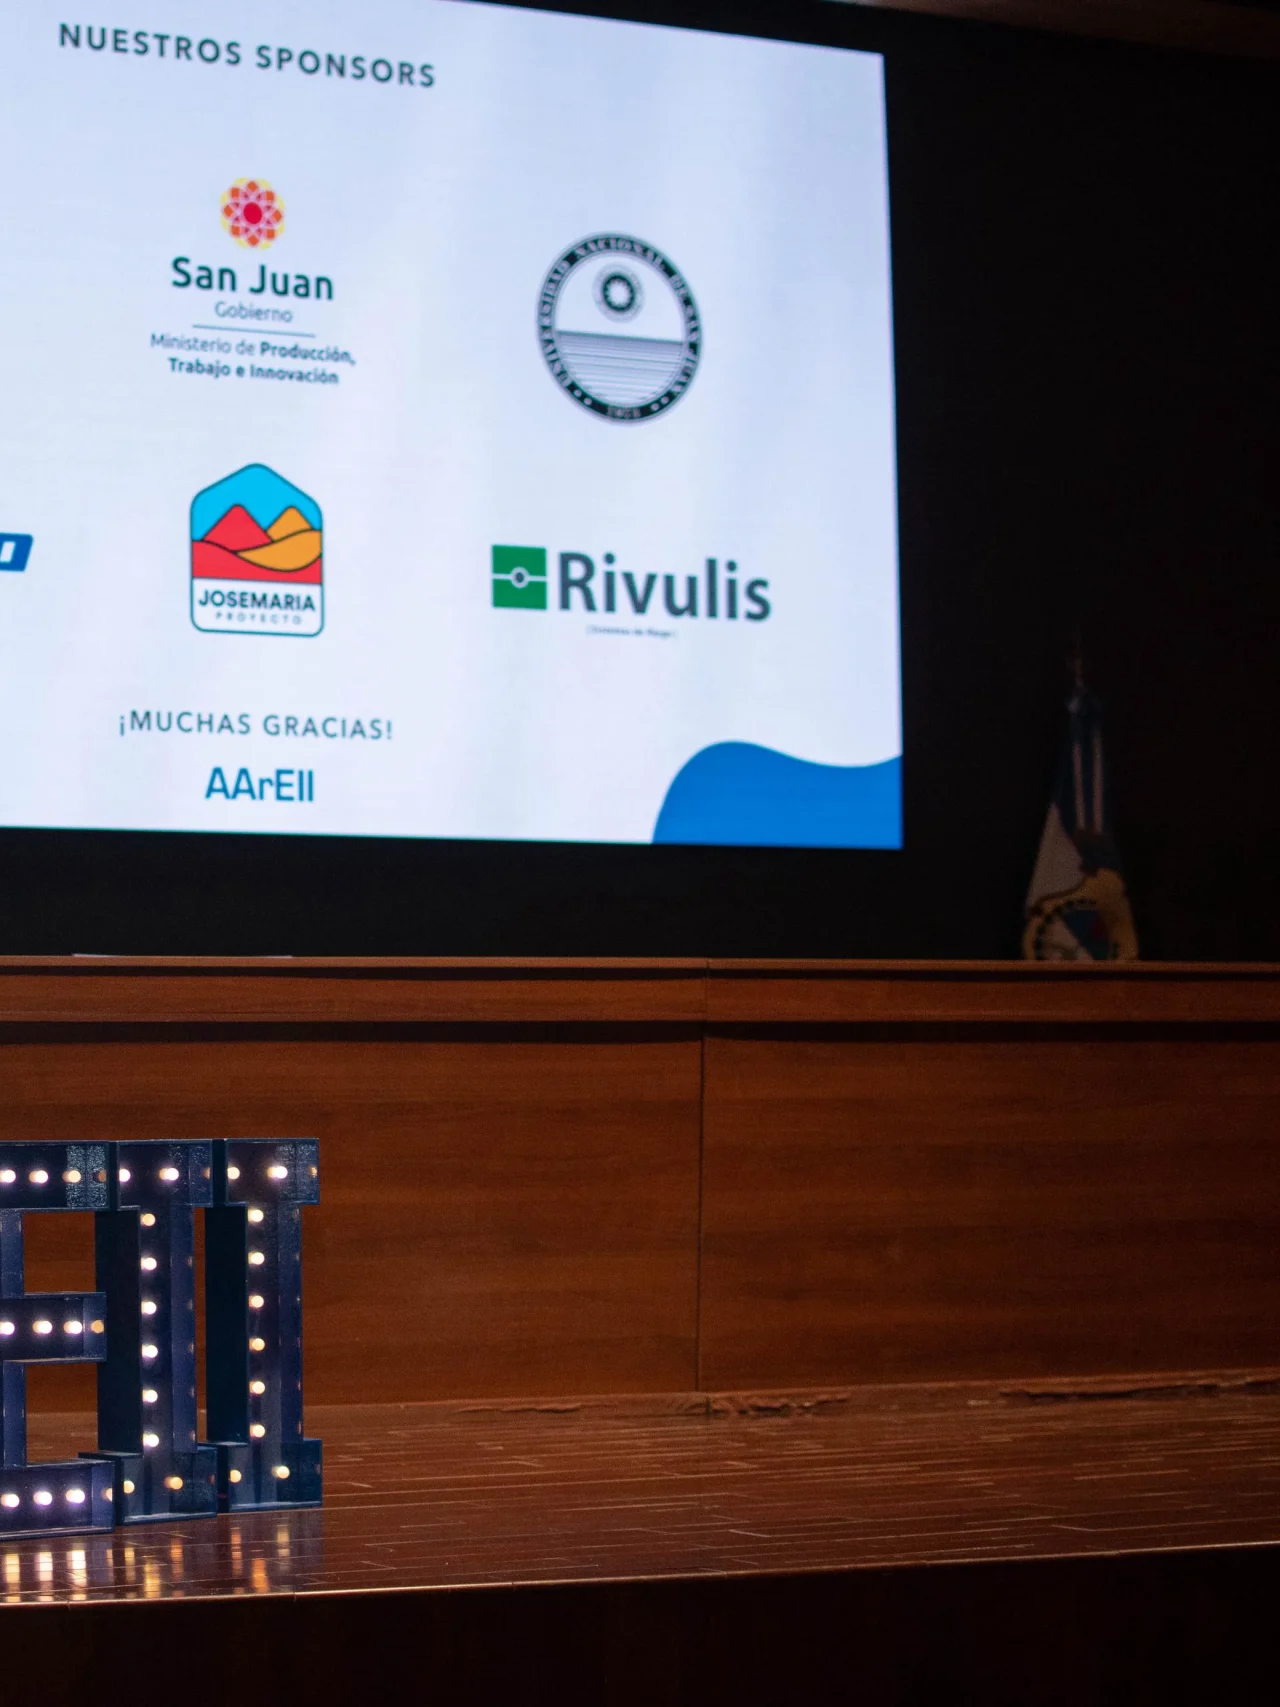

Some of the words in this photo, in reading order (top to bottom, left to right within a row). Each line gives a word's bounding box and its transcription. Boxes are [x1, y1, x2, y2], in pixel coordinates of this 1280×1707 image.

[59, 22, 241, 66] NUESTROS
[255, 45, 435, 88] SPONSORS
[171, 256, 237, 292] San
[249, 264, 334, 300] Juan
[214, 301, 294, 323] Gobierno
[150, 333, 231, 354] Ministerio
[235, 341, 256, 356] de
[260, 341, 357, 366] Producción,
[168, 357, 231, 379] Trabajo
[235, 365, 245, 377] e
[250, 364, 340, 385] Innovación
[198, 590, 316, 612] JOSEMARIA
[558, 552, 772, 622] Rivulis
[215, 612, 303, 626] PROYECTO
[119, 710, 252, 737] ¡MUCHAS
[262, 714, 393, 740] GRACIAS!
